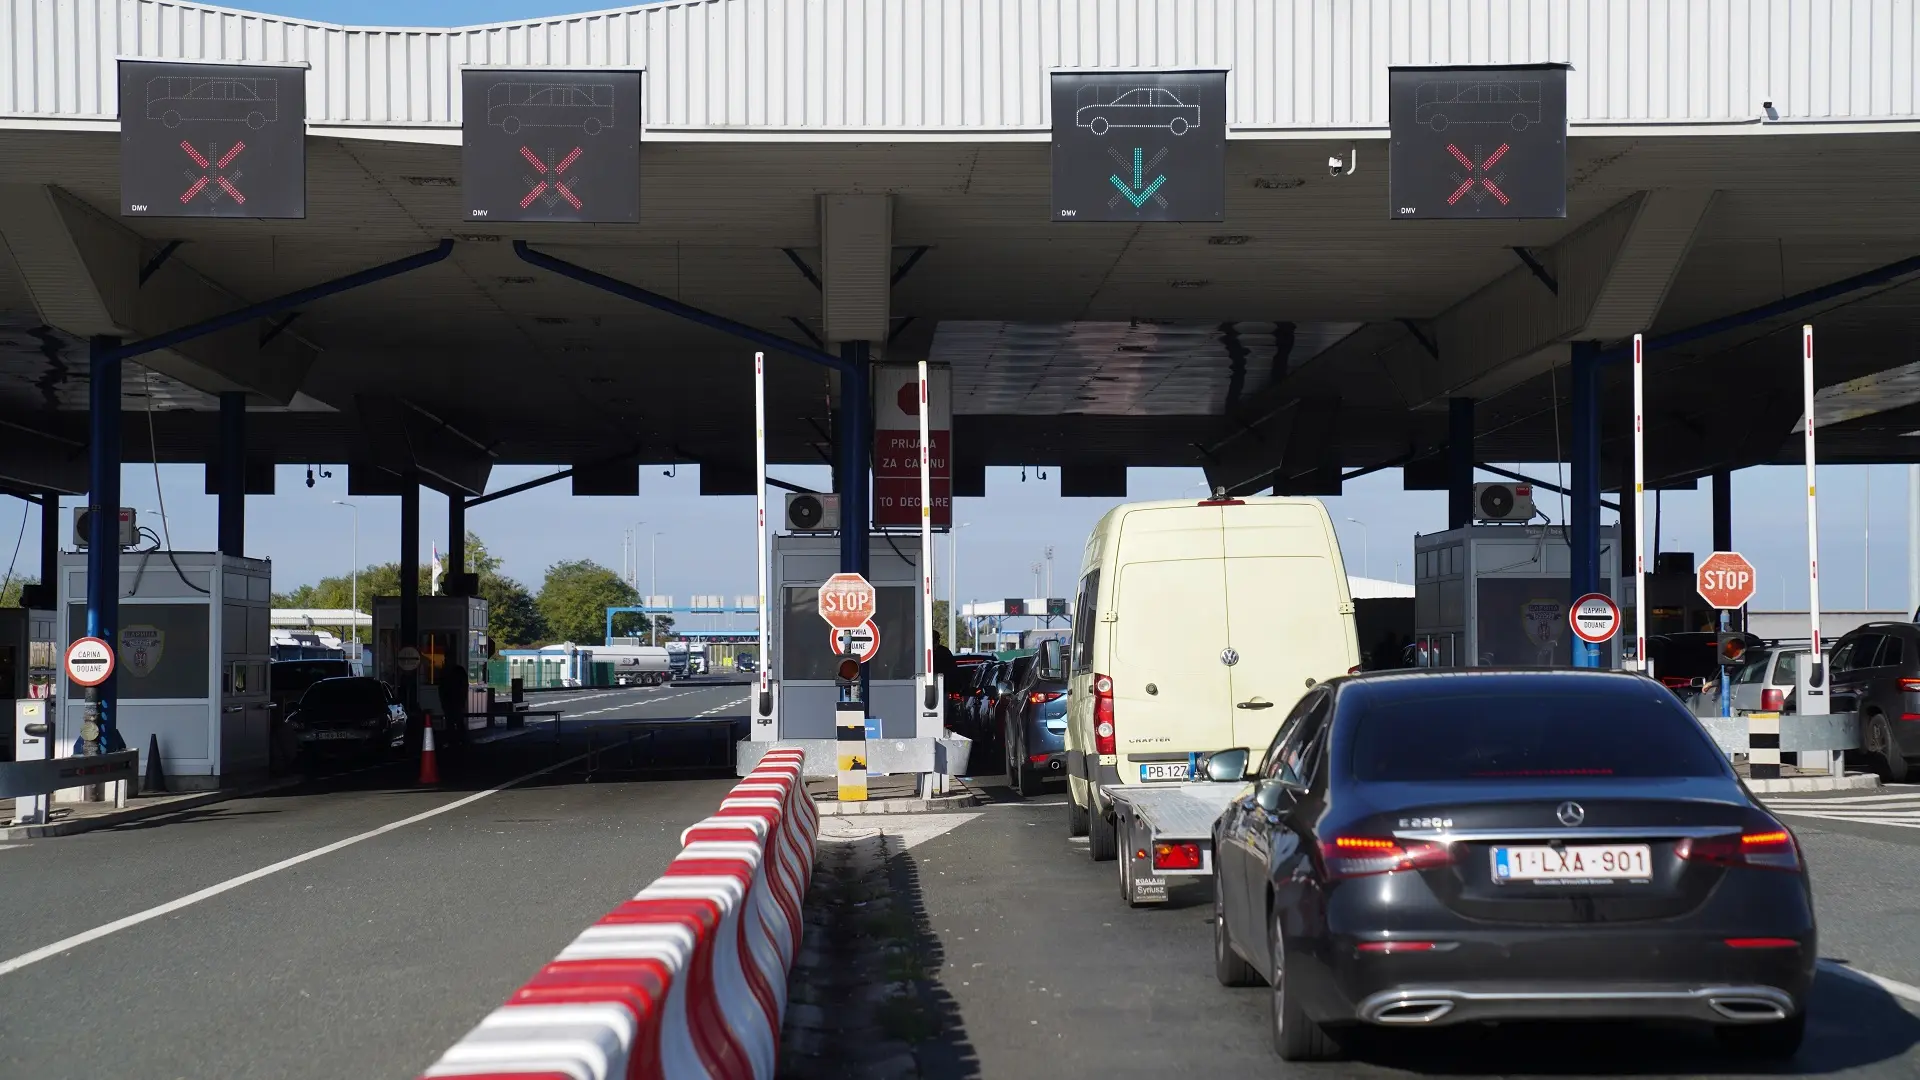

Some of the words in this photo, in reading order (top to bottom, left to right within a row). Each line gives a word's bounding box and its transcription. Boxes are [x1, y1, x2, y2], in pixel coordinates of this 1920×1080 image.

[131, 204, 148, 212] DMV
[472, 209, 488, 217] DMV
[1061, 209, 1077, 217] DMV
[891, 438, 936, 449] PRIJAA
[882, 458, 897, 468] ZA
[904, 458, 945, 468] CANU
[879, 497, 893, 507] TO
[900, 497, 949, 507] DECARE
[1704, 570, 1749, 590] STOP
[825, 591, 869, 612] STOP
